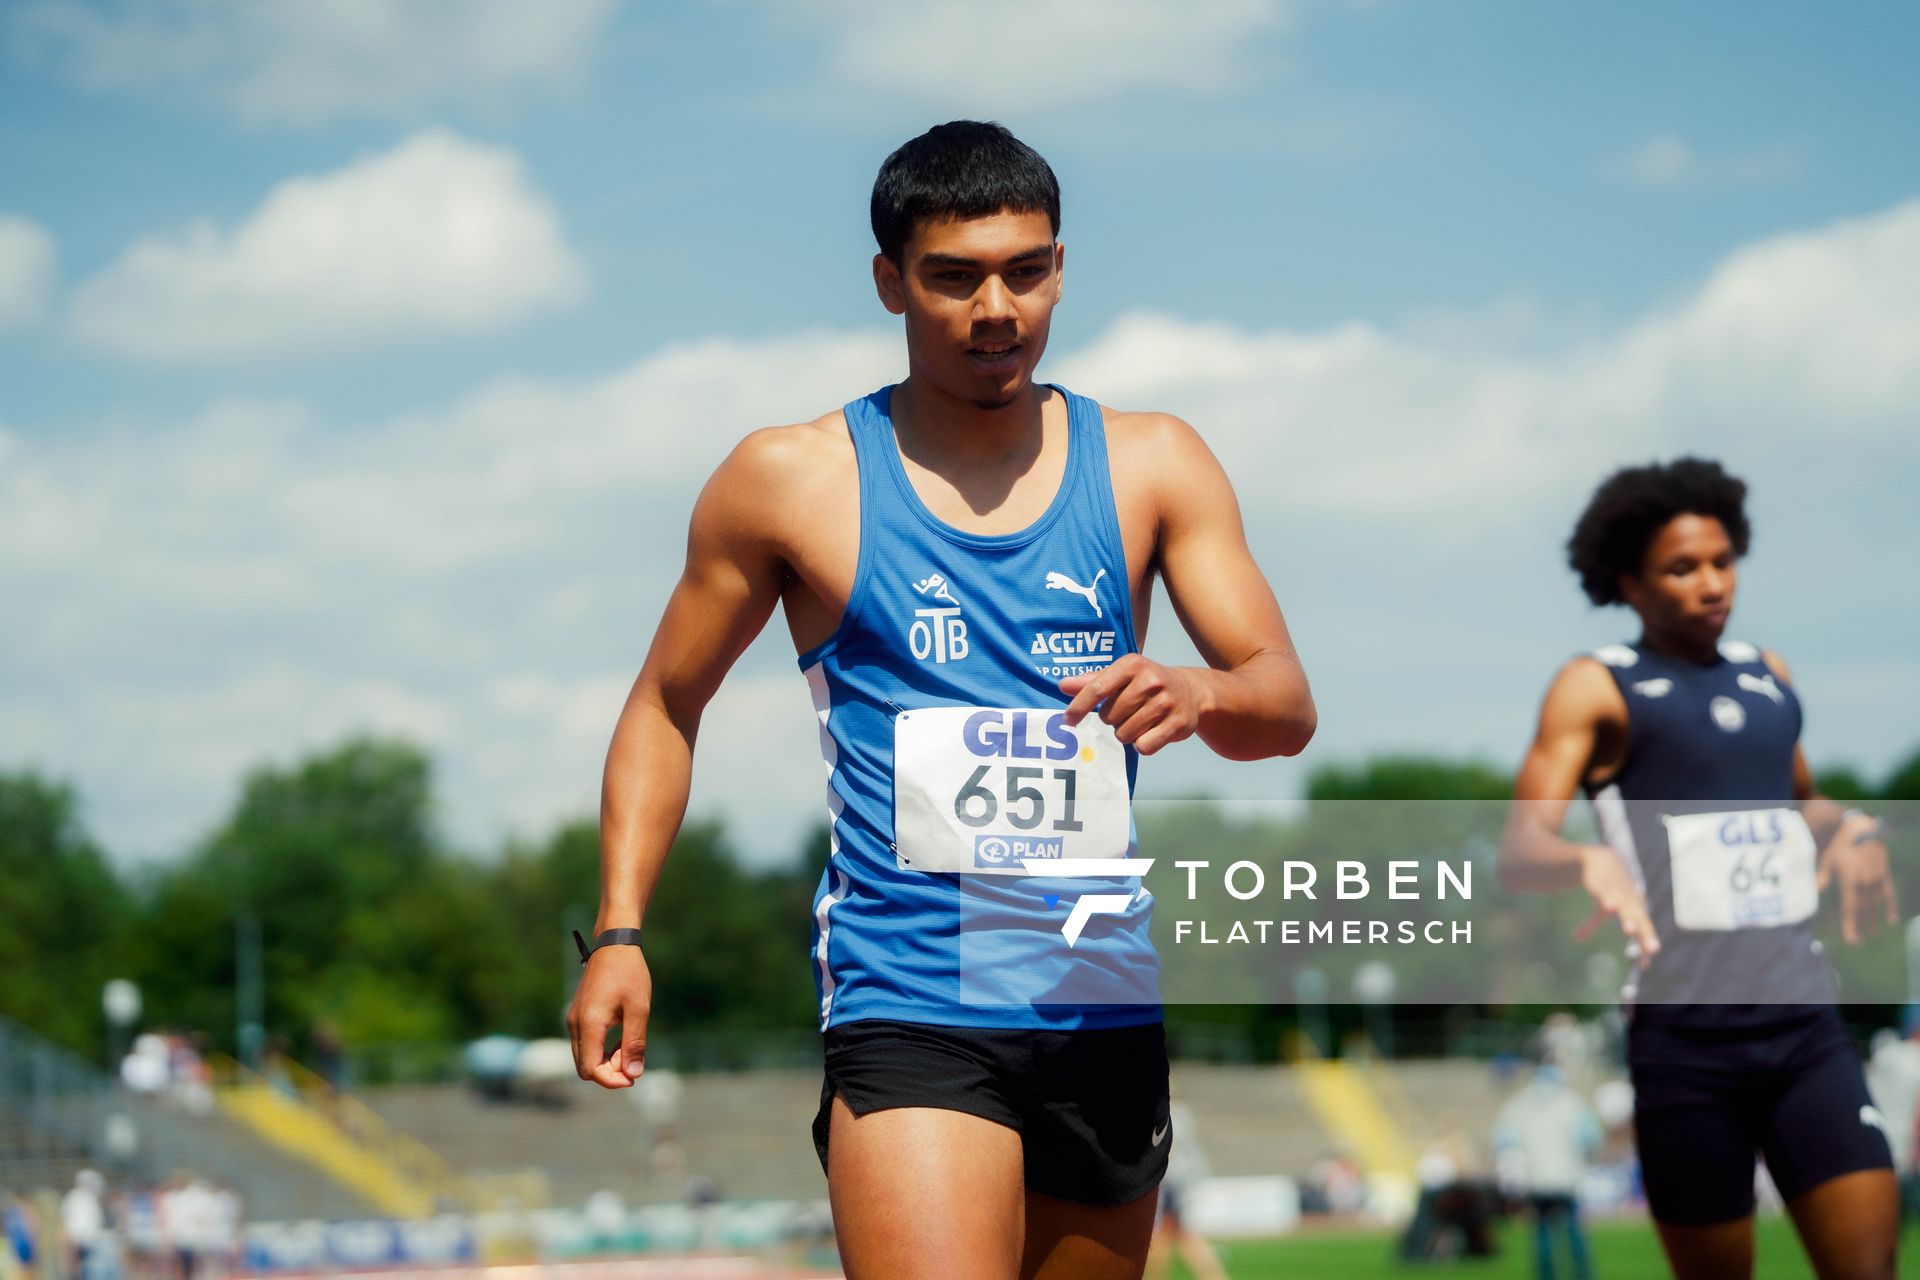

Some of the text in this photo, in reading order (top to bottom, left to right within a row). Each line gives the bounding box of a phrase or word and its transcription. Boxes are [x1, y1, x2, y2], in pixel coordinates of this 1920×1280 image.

[909, 608, 969, 663] OTB
[954, 765, 1083, 832] 651
[1013, 842, 1059, 858] PLAN
[1730, 849, 1781, 892] 64
